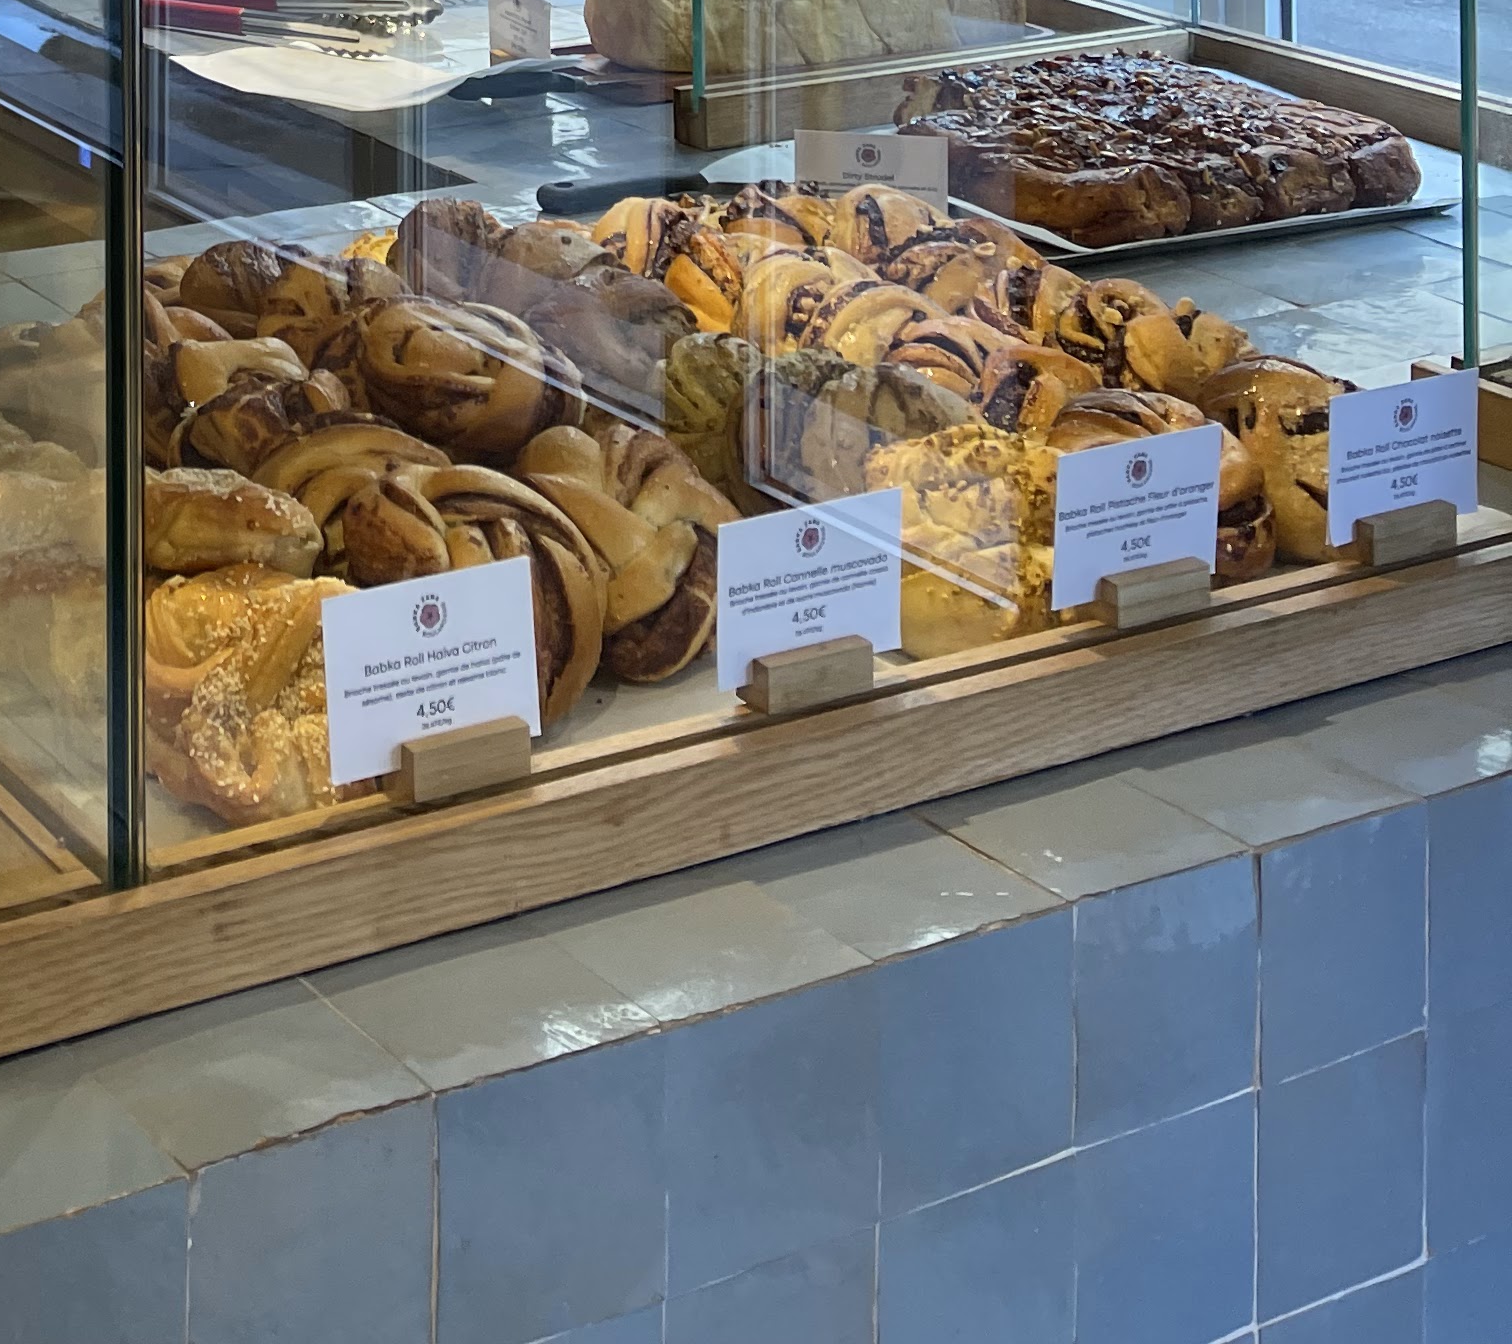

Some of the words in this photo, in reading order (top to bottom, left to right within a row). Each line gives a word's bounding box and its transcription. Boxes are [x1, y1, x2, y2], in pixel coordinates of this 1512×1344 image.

[842, 172, 862, 182] Dirty
[1347, 448, 1374, 460] Babka
[1375, 443, 1390, 454] Roll
[1392, 435, 1428, 451] Chocolat
[1390, 473, 1418, 490] 4,50€
[1059, 508, 1088, 522] Babka
[1090, 503, 1106, 514] Roll
[1148, 491, 1169, 502] Fleur
[1172, 481, 1215, 497] d'oranger
[1120, 535, 1151, 552] 4,50€
[728, 583, 761, 598] Babka
[763, 576, 781, 589] Roll
[784, 566, 828, 584] Cannelle
[830, 553, 888, 573] muscovado
[791, 605, 827, 624] 4,50€
[364, 658, 401, 678] Babka
[404, 653, 425, 668] Roll
[427, 647, 460, 663] Halva
[462, 637, 497, 654] Citron
[416, 697, 456, 718] 4,50€
